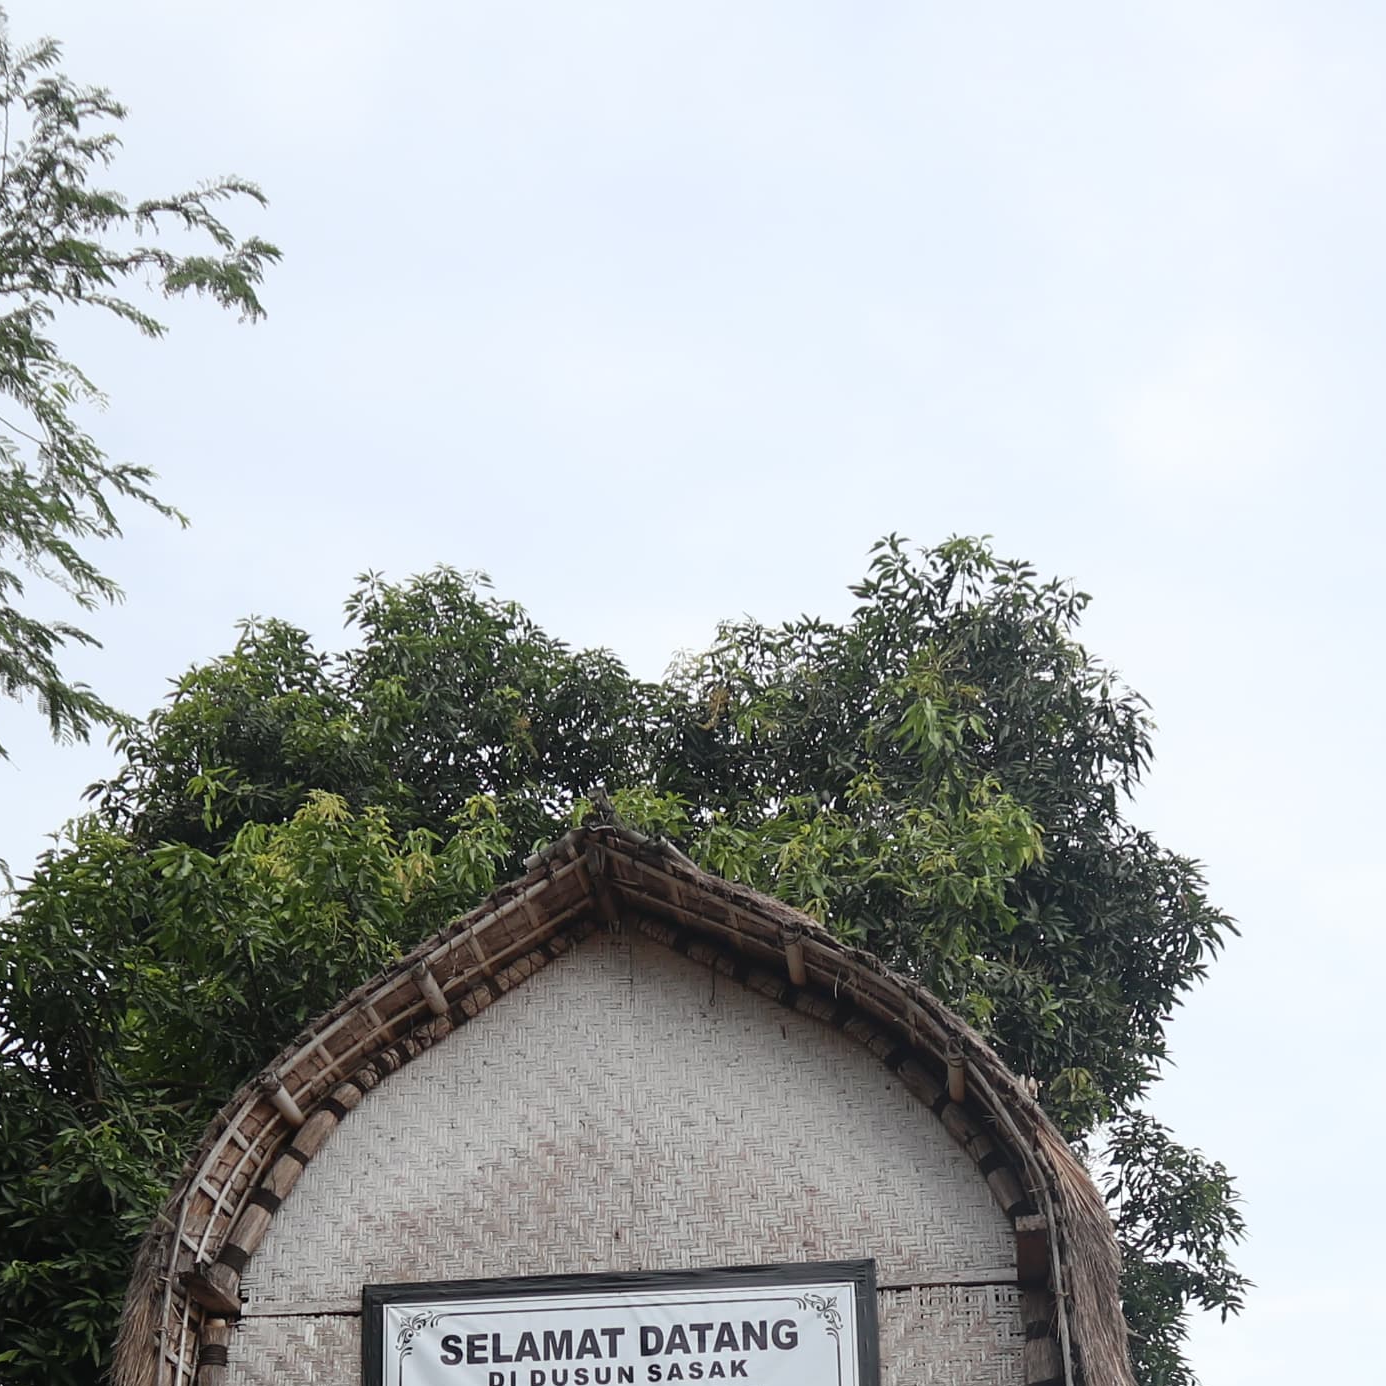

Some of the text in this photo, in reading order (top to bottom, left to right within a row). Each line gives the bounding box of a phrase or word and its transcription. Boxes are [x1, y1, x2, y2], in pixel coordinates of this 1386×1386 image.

[440, 1319, 799, 1366] SELAMAT DATANG
[647, 1360, 748, 1382] SASAK
